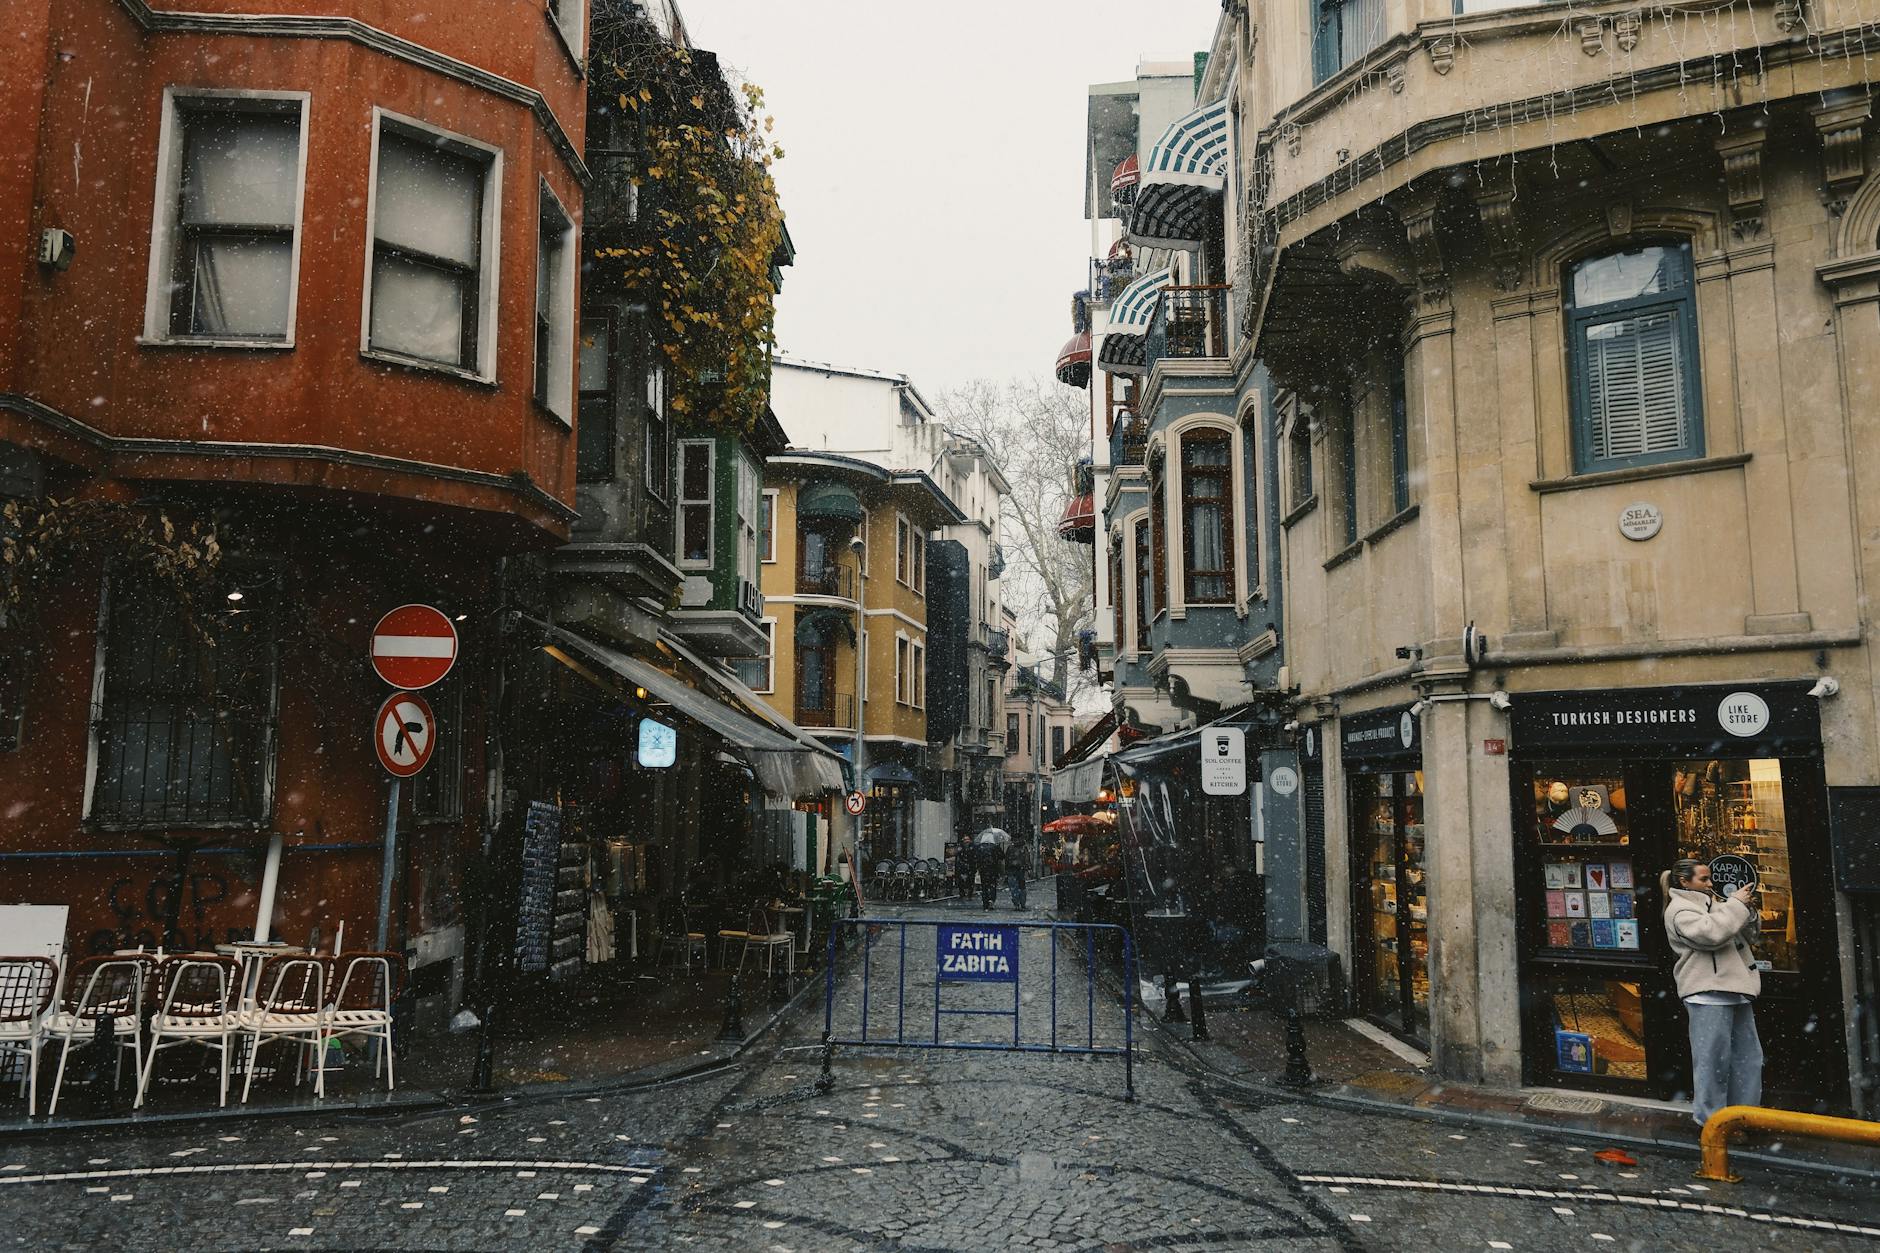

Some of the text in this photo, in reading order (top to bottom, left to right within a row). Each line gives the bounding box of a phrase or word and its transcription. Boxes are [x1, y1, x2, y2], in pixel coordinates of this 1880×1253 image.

[1728, 705, 1749, 714] LIKE
[1552, 709, 1696, 725] TURKISH DESIGNERS
[1729, 714, 1758, 723] STORE
[943, 955, 1010, 973] ZABITA
